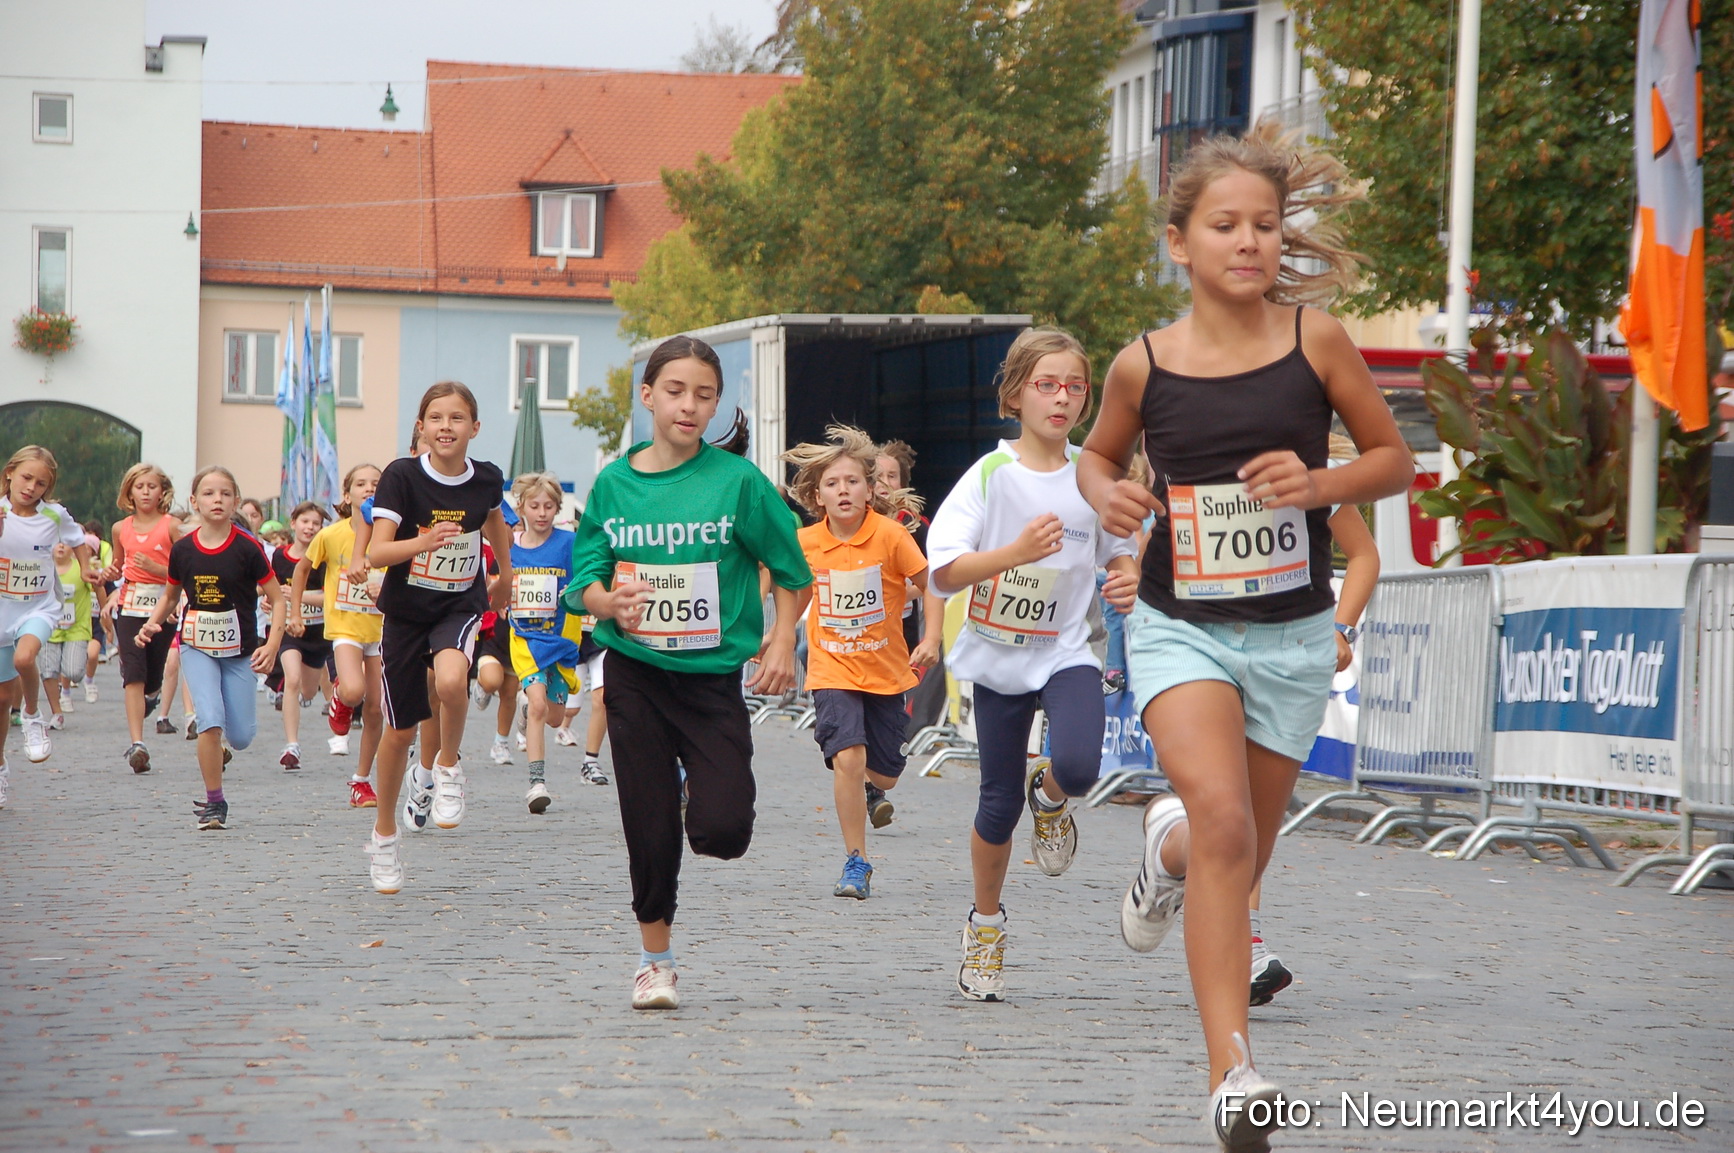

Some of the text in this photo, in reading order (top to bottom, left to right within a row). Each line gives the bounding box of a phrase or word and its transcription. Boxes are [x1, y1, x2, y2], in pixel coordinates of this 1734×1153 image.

[1202, 494, 1263, 520] Sophie
[603, 515, 733, 554] Sinupret
[1176, 529, 1191, 545] K5
[1208, 521, 1297, 561] 7006
[12, 562, 41, 572] Michelle
[435, 555, 476, 573] 7177
[512, 566, 567, 577] EUMARKTER
[12, 575, 47, 588] 7147
[640, 573, 685, 589] Natalie
[1004, 570, 1040, 589] Clara
[1260, 568, 1308, 585] PFLEIDERER
[520, 591, 552, 603] 7068
[977, 585, 988, 598] K5
[136, 596, 161, 606] 729
[835, 590, 877, 610] 7229
[1000, 593, 1058, 622] 7091
[643, 598, 709, 622] 7056
[197, 616, 233, 626] Katharina
[199, 629, 236, 643] 7132
[678, 634, 719, 644] PFLEIDERER
